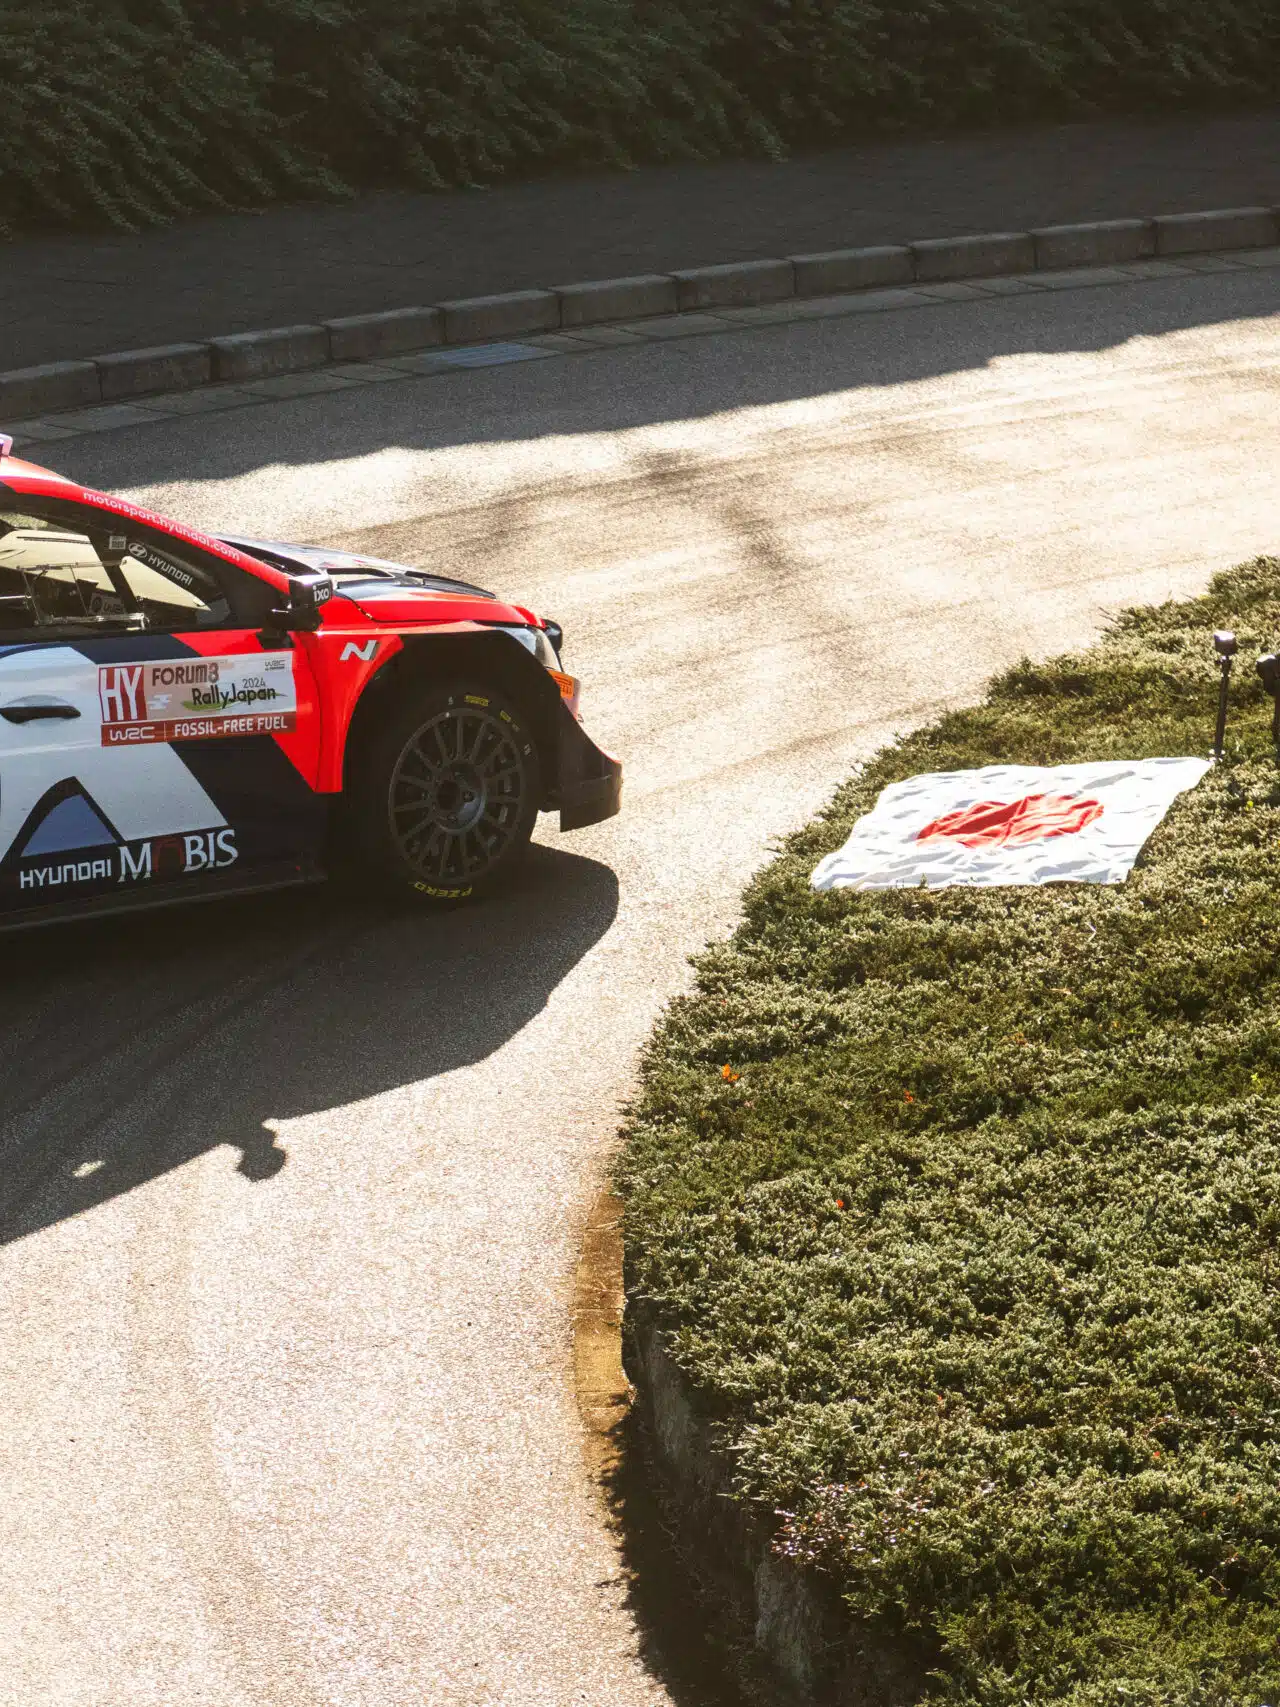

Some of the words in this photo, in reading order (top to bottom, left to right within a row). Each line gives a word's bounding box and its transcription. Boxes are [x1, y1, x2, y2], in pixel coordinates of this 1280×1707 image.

[83, 491, 241, 562] motorsport.hyundai.com
[148, 555, 194, 586] HYUNDAI
[313, 585, 330, 602] ixo
[99, 665, 143, 723] HY
[242, 676, 267, 689] 2024
[109, 726, 156, 742] WRC
[173, 719, 253, 738] FOSSIL-FREE
[257, 715, 288, 731] FUEL
[119, 829, 238, 882] MOBIS
[19, 858, 113, 890] HYUNDAI
